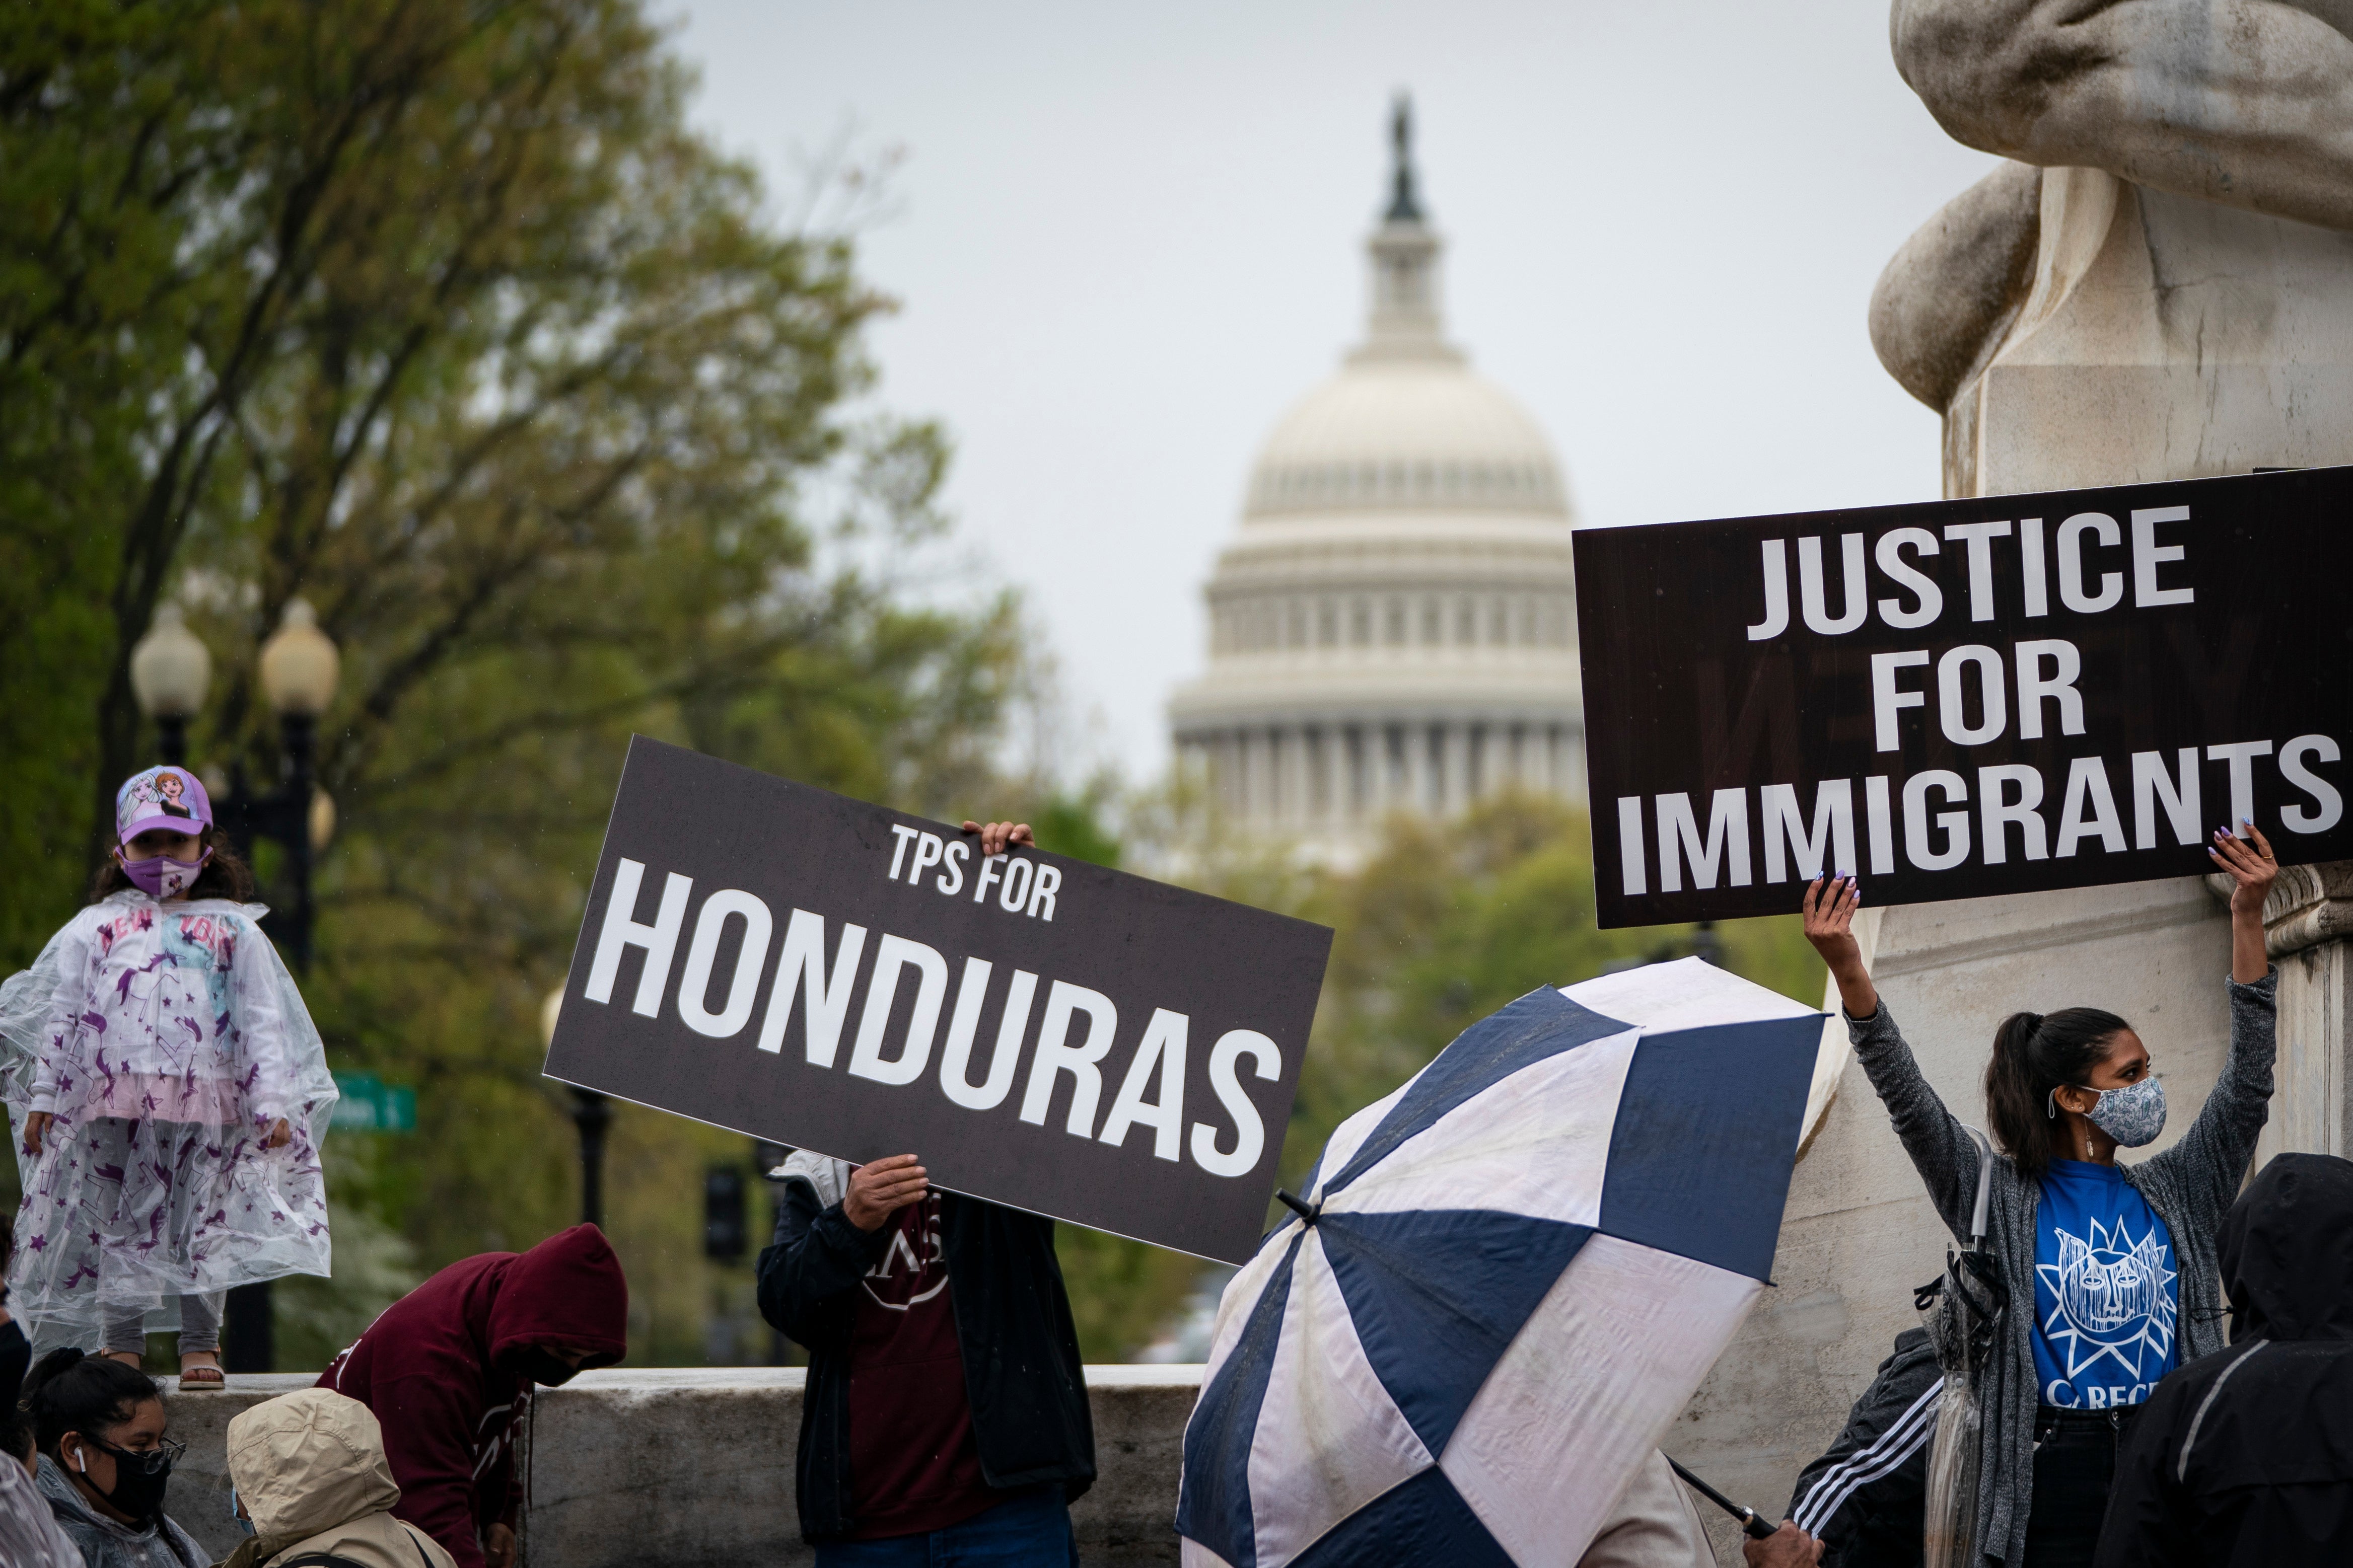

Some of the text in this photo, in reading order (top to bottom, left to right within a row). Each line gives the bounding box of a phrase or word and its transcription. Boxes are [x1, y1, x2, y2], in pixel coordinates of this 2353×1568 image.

[1748, 505, 2194, 640] JUSTICE
[1872, 639, 2086, 752] FOR
[889, 824, 1061, 921] TPS FOR
[1618, 735, 2342, 895] IMMIGRANTS
[585, 858, 1281, 1177] HONDURAS
